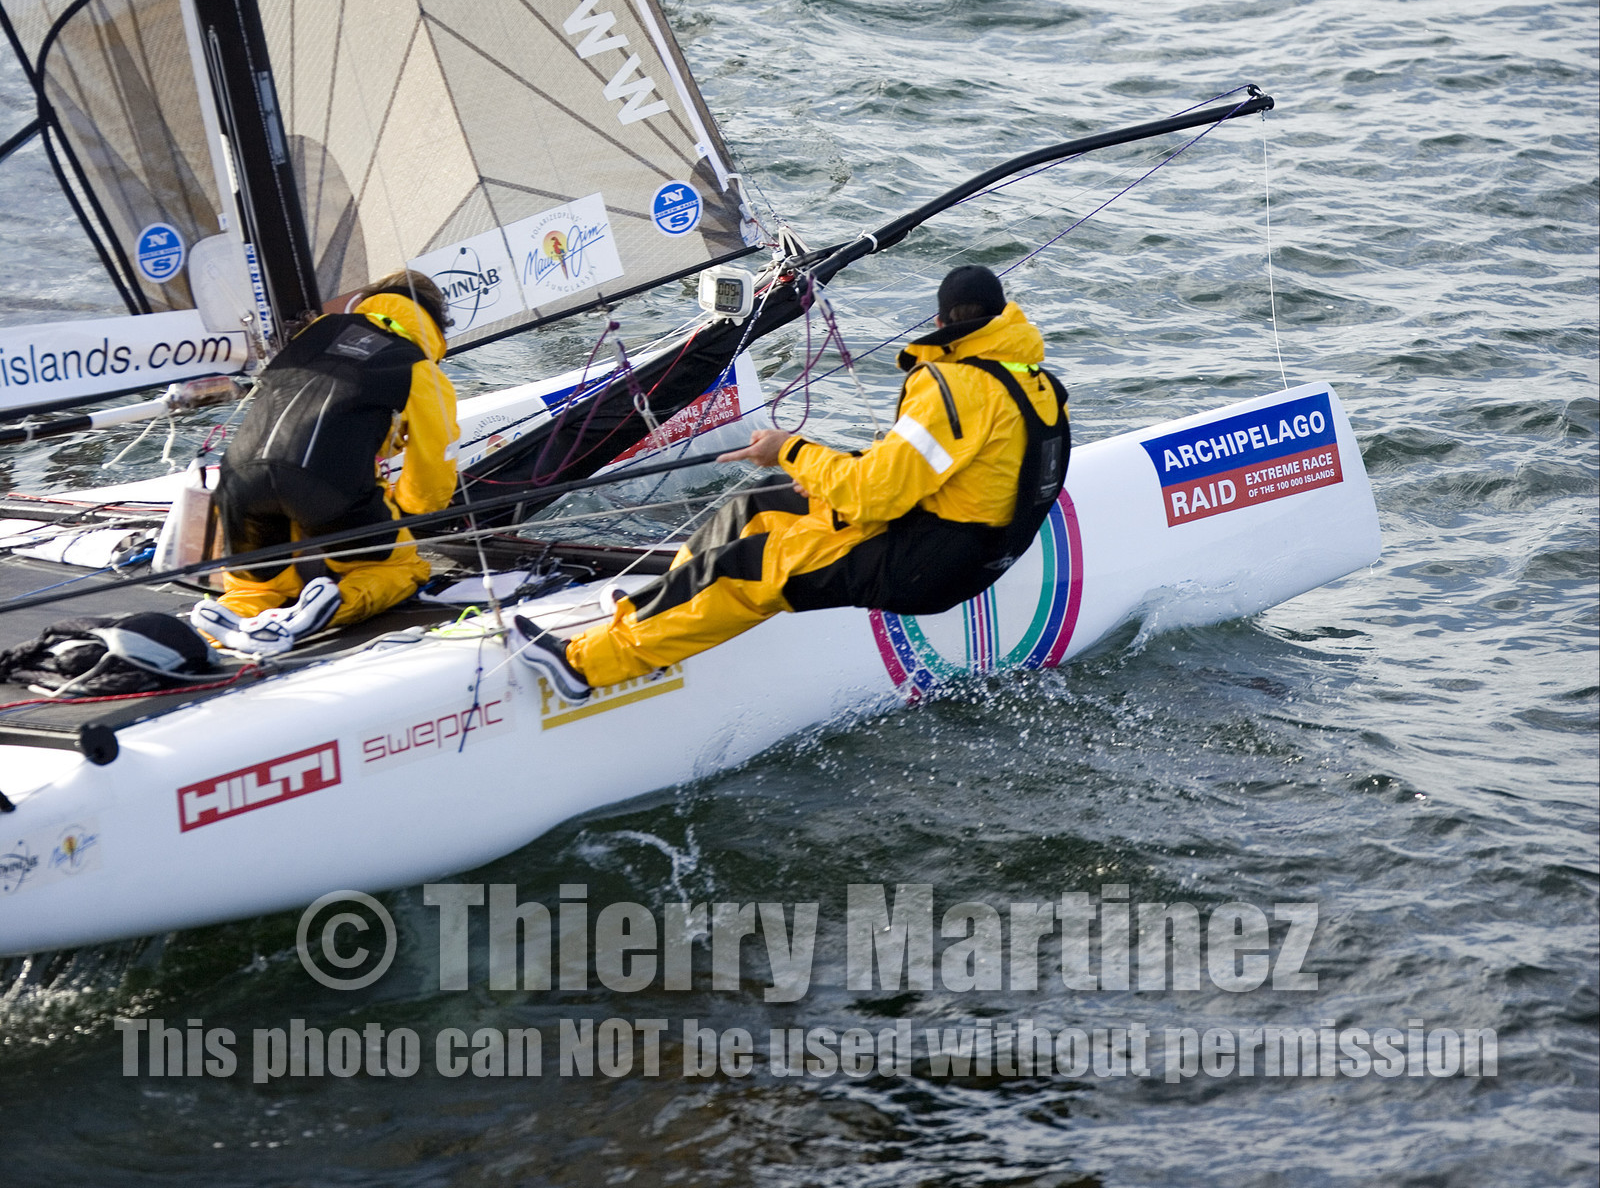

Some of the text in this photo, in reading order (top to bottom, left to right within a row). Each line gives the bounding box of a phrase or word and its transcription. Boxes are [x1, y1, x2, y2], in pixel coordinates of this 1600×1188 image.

[1163, 410, 1326, 472] ARCHIPELAGO
[1244, 452, 1333, 486] EXTREME RACE
[1248, 468, 1335, 498] OF THE 100 000 ISLANDS
[1171, 478, 1237, 518] RAID
[182, 746, 337, 826] HILTI
